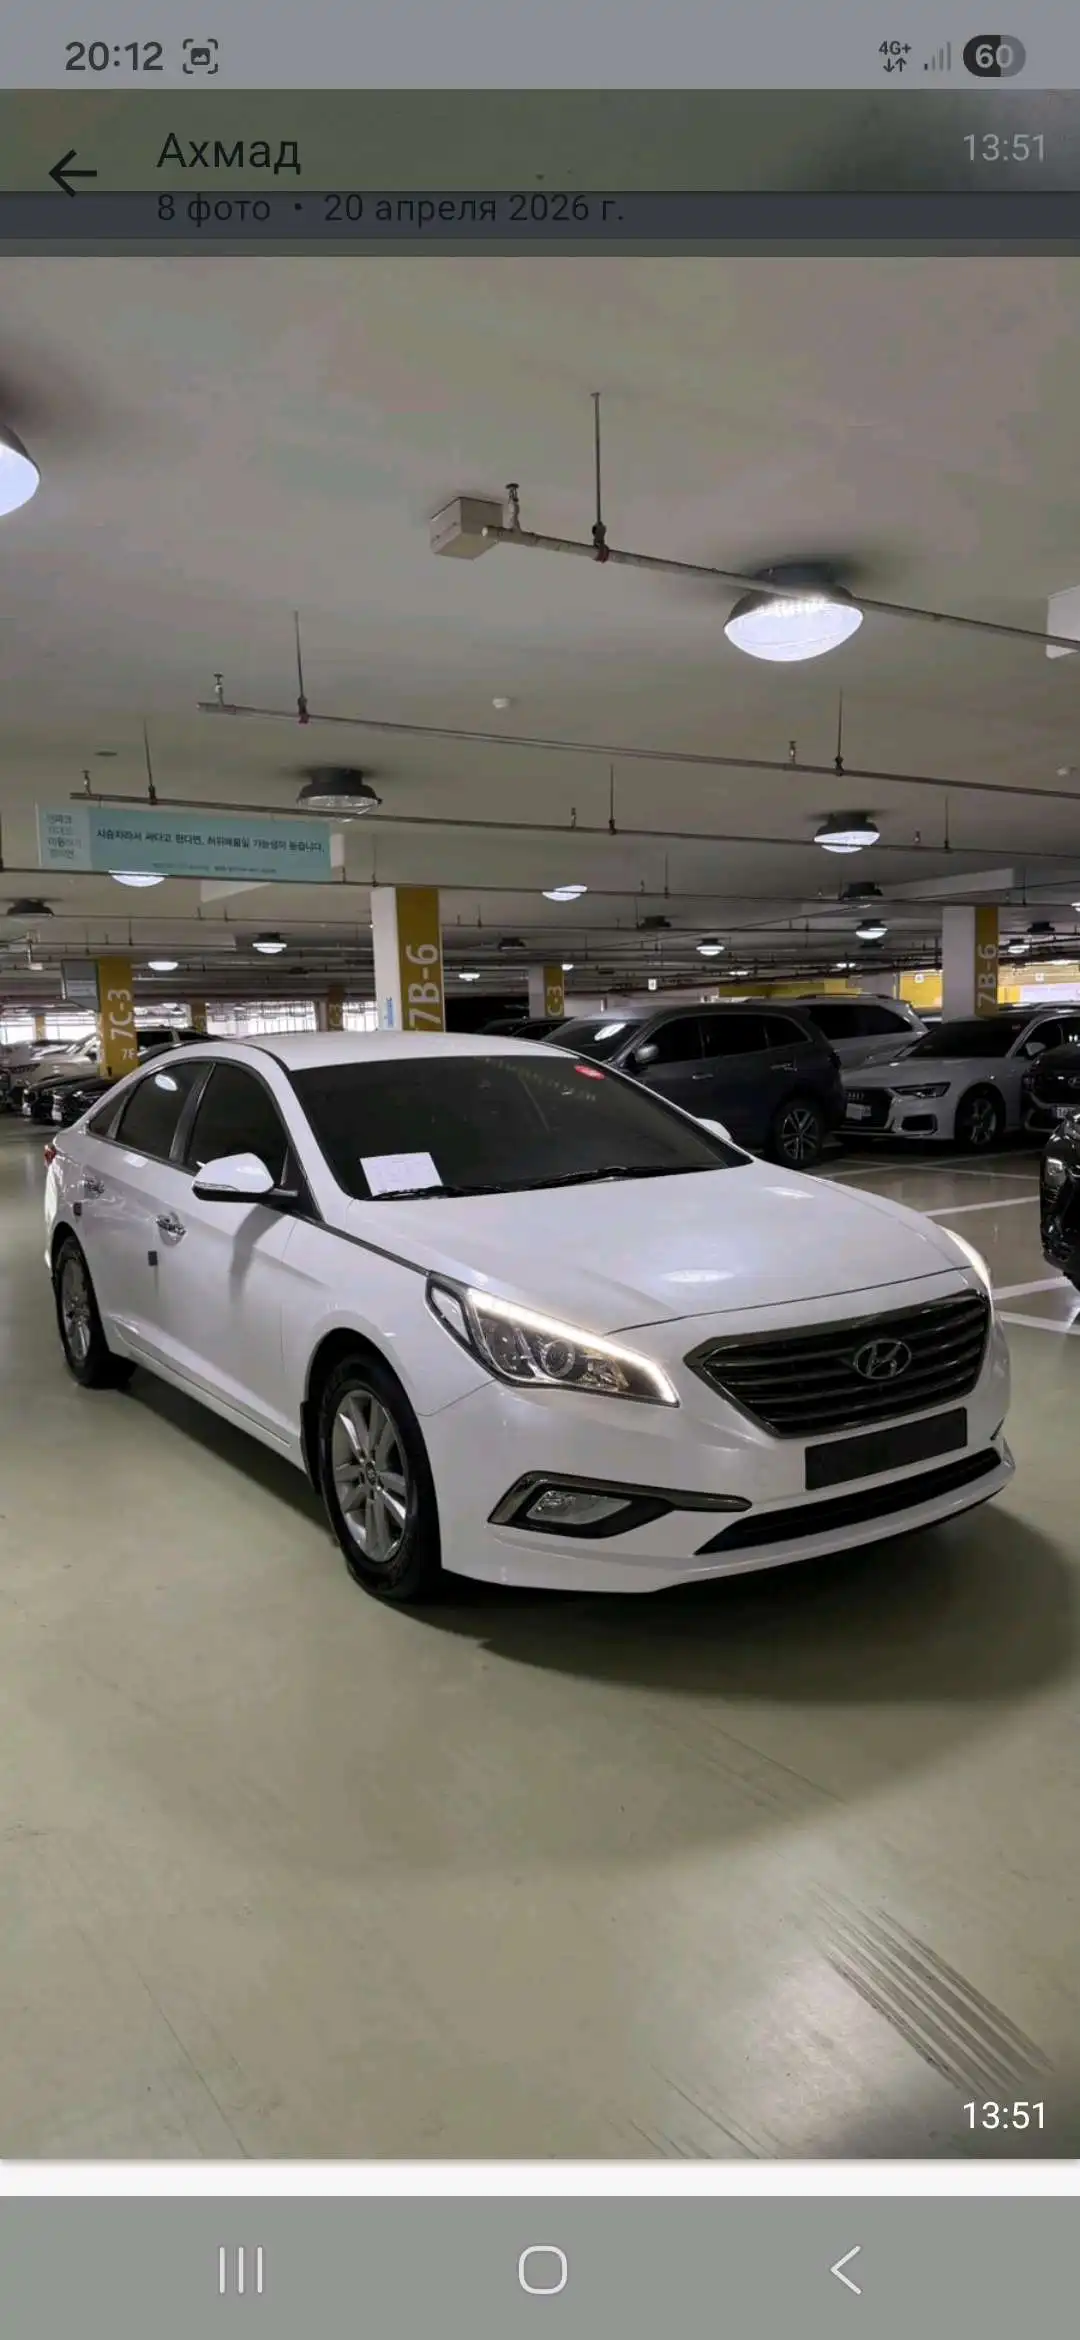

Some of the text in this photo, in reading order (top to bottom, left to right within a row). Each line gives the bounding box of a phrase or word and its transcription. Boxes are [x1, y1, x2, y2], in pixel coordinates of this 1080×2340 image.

[405, 944, 441, 1029] 7B-6
[546, 985, 564, 1016] C-3
[978, 943, 997, 1009] 7B-6
[108, 988, 135, 1041] 7C-3
